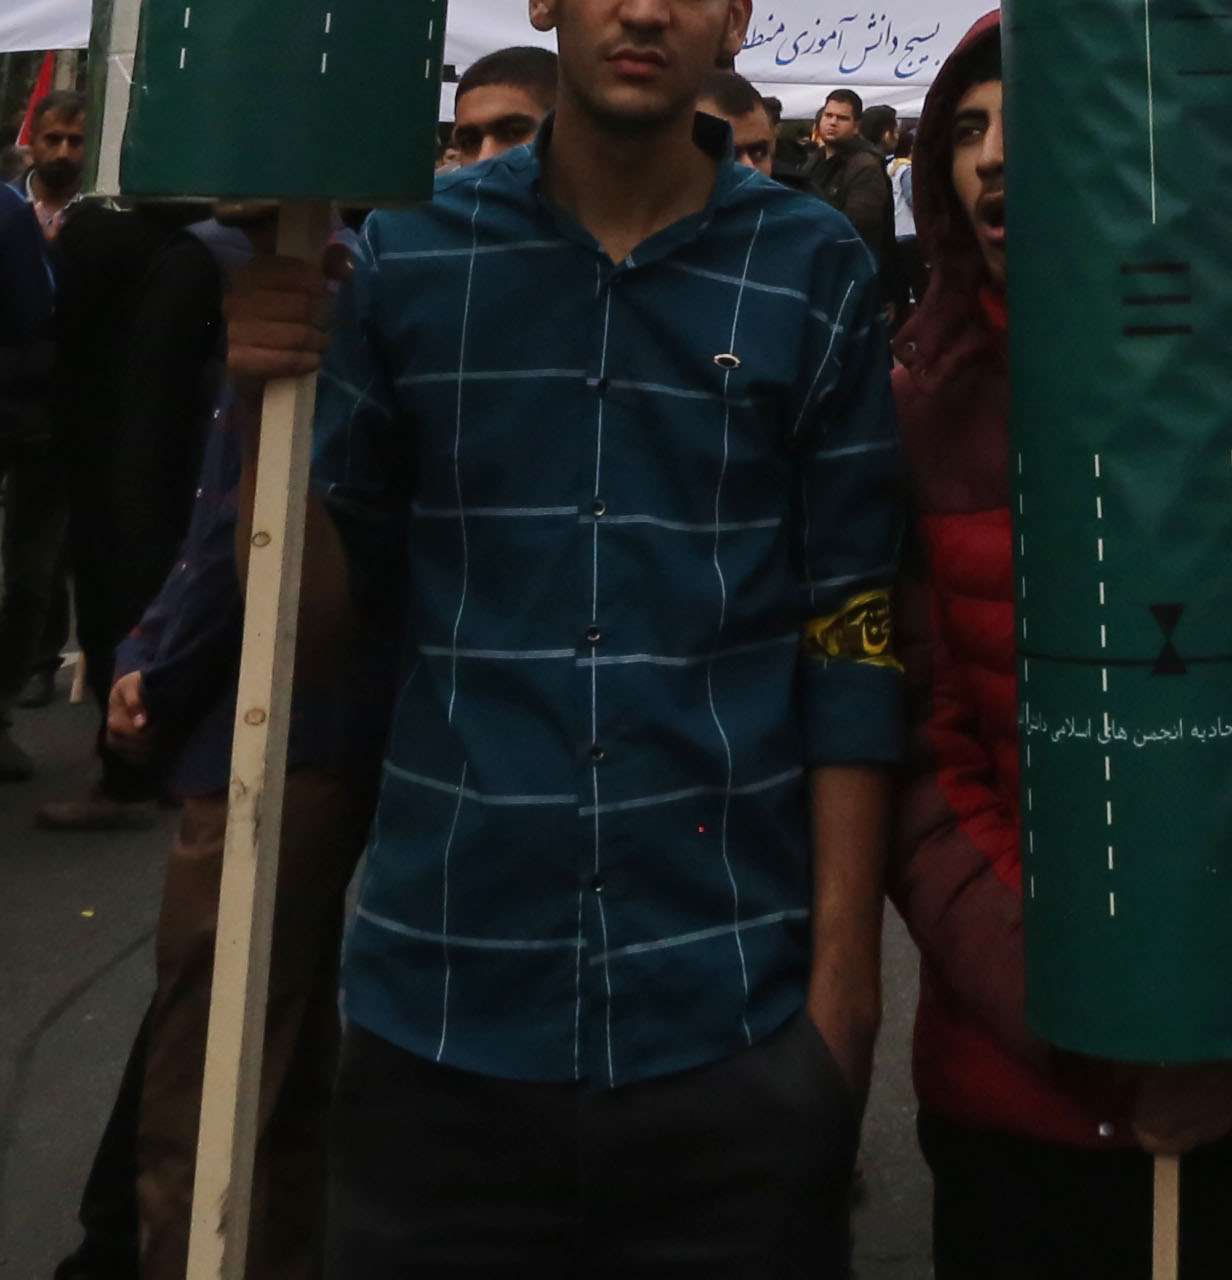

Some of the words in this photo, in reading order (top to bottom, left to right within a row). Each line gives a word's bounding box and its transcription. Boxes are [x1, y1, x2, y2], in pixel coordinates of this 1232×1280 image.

[775, 13, 859, 66] آموزی
[839, 13, 898, 74] دانش
[894, 22, 941, 79] بسیج
[1051, 716, 1092, 743] اسلامی
[1097, 716, 1128, 745] های
[1132, 717, 1183, 747] انجمن
